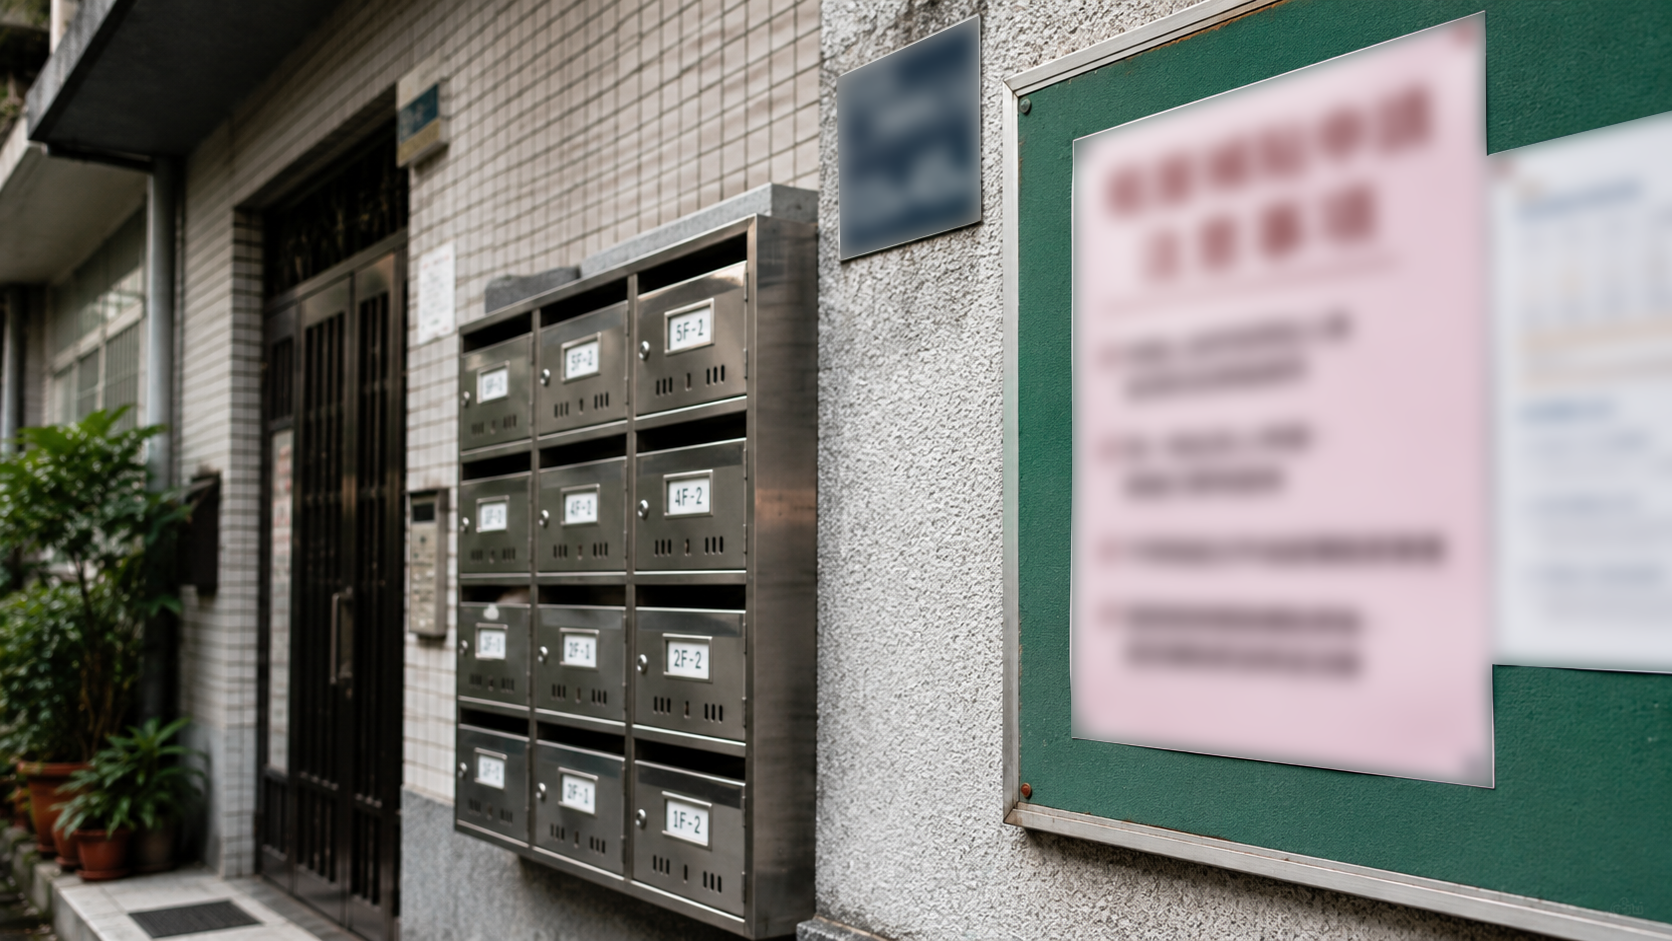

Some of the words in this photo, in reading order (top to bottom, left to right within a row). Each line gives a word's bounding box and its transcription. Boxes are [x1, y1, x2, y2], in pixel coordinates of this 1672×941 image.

[676, 318, 704, 342] 5F-2
[675, 486, 702, 506] 4F-2
[674, 650, 702, 670] 2F-2
[673, 810, 700, 834] 1F-2
